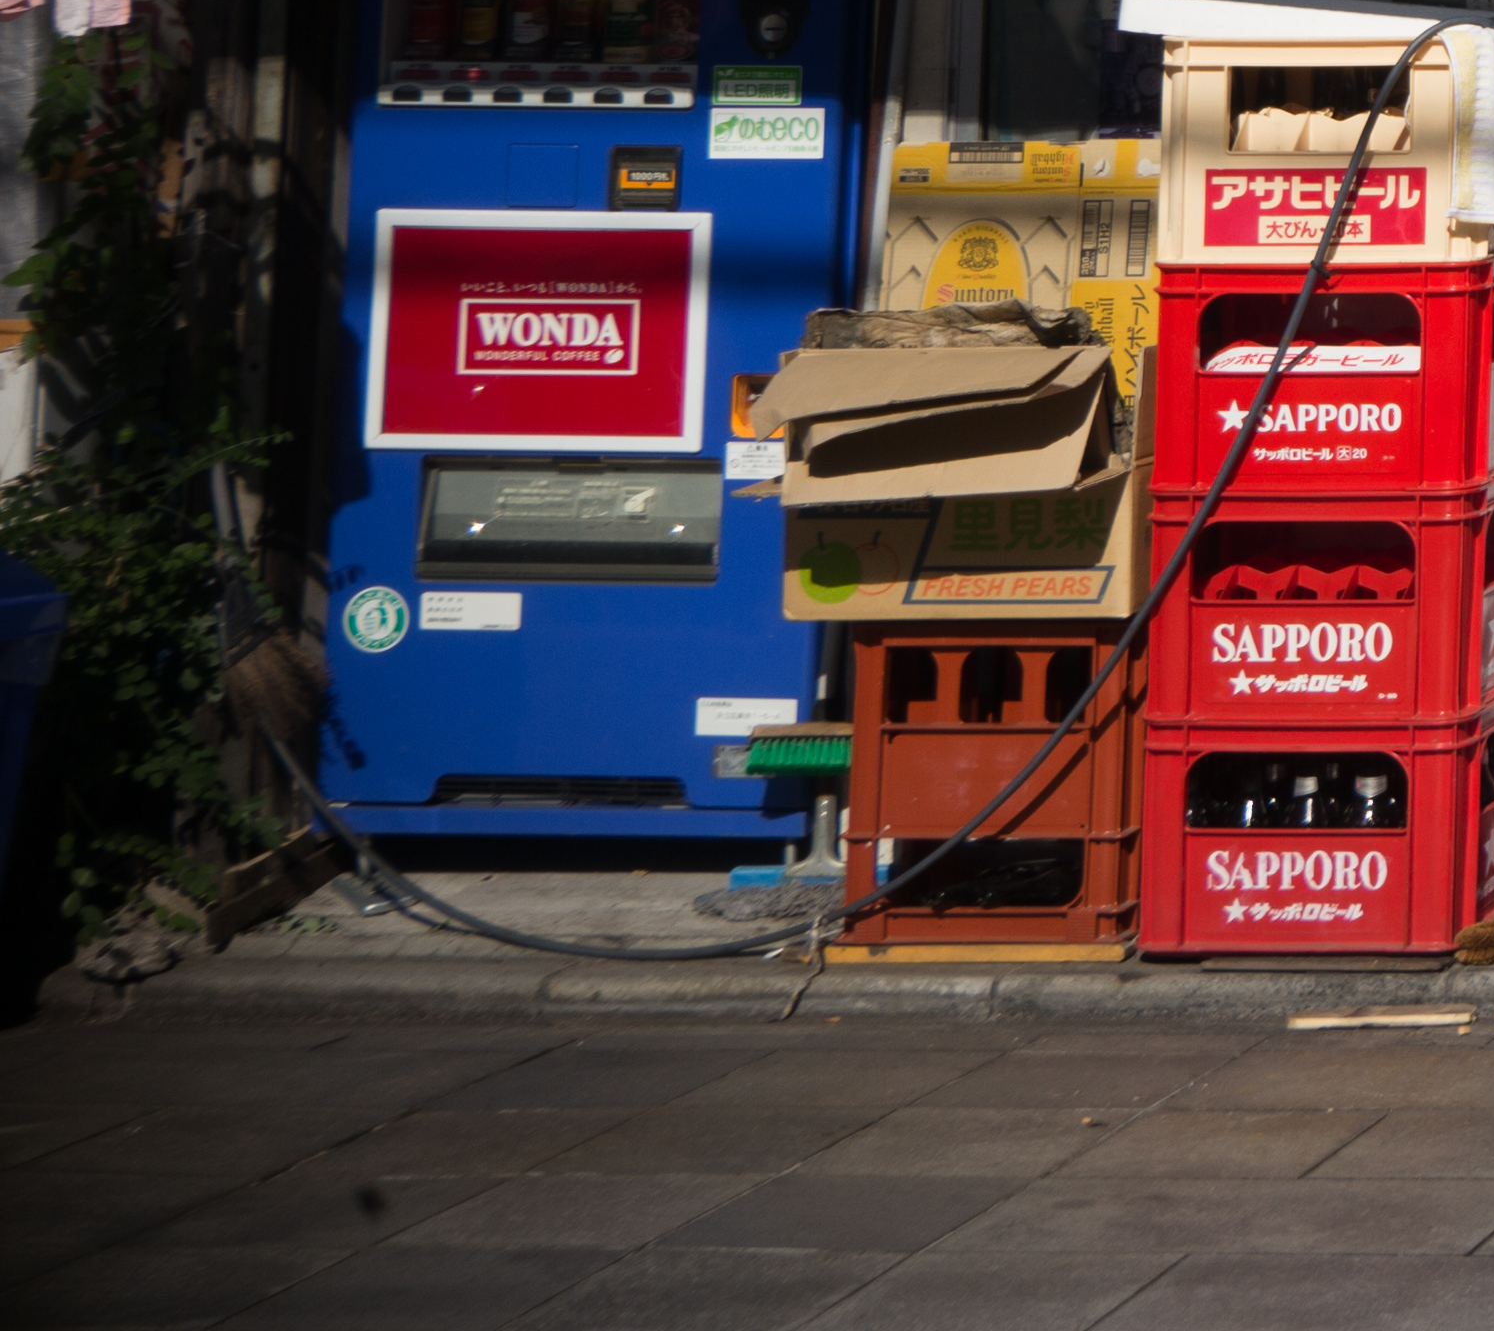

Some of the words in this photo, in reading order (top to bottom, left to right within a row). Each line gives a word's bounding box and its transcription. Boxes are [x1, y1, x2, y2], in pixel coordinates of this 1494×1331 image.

[724, 83, 790, 99] LED照明
[1211, 175, 1421, 210] アサヒビール
[1099, 223, 1111, 255] S1H2
[1266, 220, 1364, 239] 大びん・0本
[475, 312, 624, 347] WONDA
[473, 350, 549, 361] WONDERFUL
[552, 350, 600, 361] COFFEE
[1256, 403, 1402, 432] SAPPORO
[1254, 446, 1333, 461] サッポロビール
[1352, 448, 1367, 458] 20
[951, 498, 1108, 552] 里見梨
[922, 577, 1008, 596] FRESH
[1011, 575, 1093, 596] PEARS
[1212, 622, 1393, 664] SAPPORO
[1253, 673, 1368, 696] サッポロビール
[1206, 849, 1389, 892] SAPPORO
[1249, 901, 1364, 925] サッポロビール
